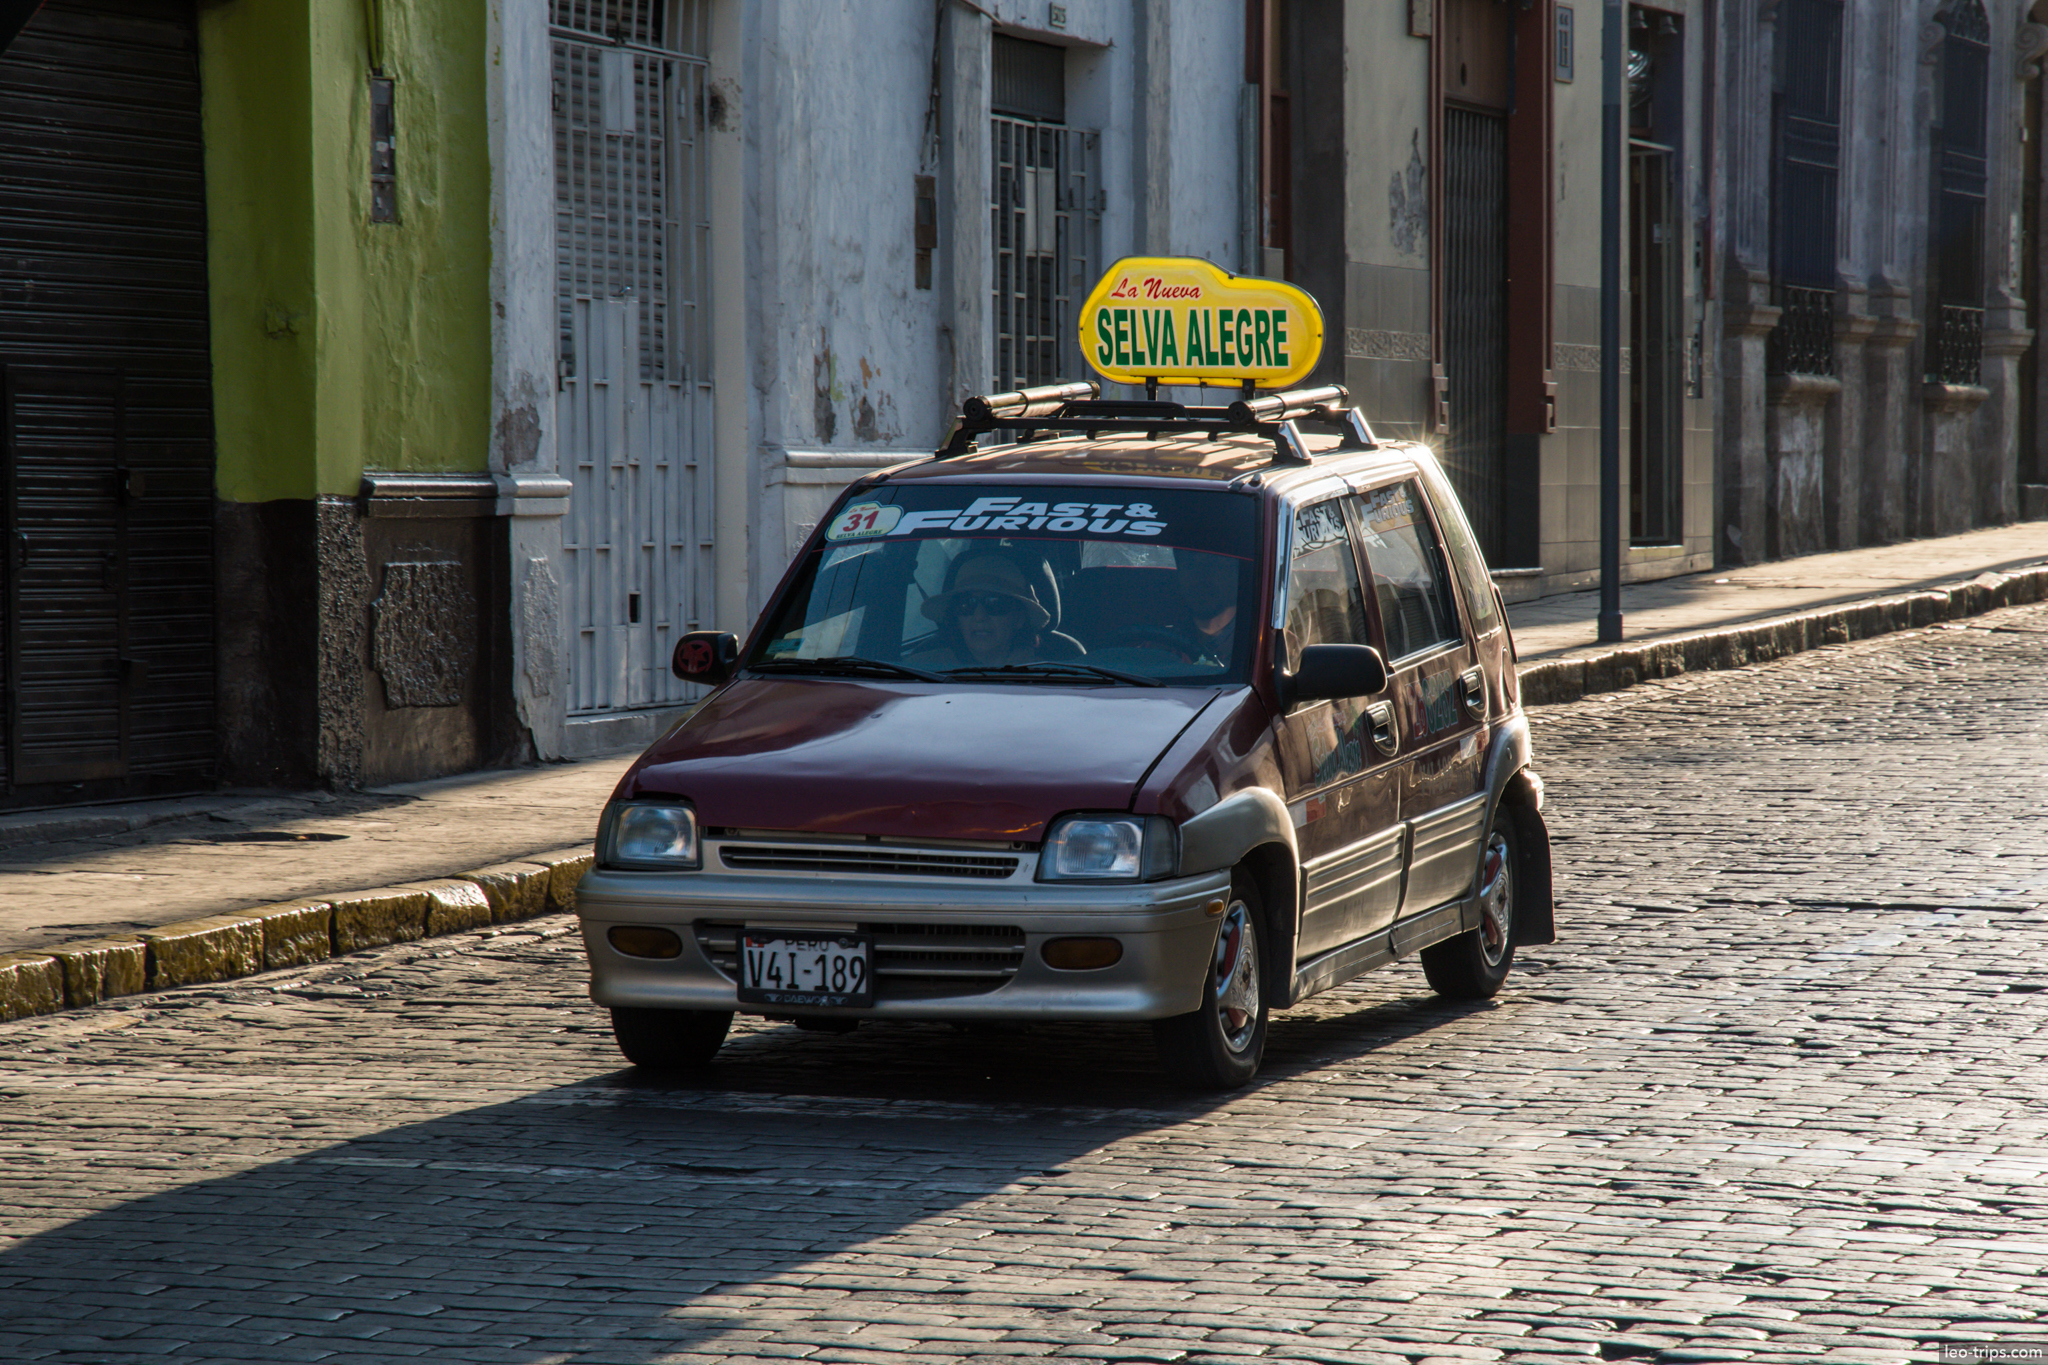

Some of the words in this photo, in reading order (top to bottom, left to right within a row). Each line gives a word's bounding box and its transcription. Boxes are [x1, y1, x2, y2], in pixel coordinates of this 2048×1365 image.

[1111, 277, 1138, 298] La
[1143, 277, 1201, 299] Nueva
[1098, 308, 1179, 366] SELVA
[1186, 308, 1289, 367] ALEGRE
[842, 510, 879, 532] 31
[887, 510, 1168, 536] FURIOUS
[1361, 499, 1415, 528] FURIOUS
[857, 529, 882, 537] ALEGRE
[748, 950, 866, 993] V4I-189
